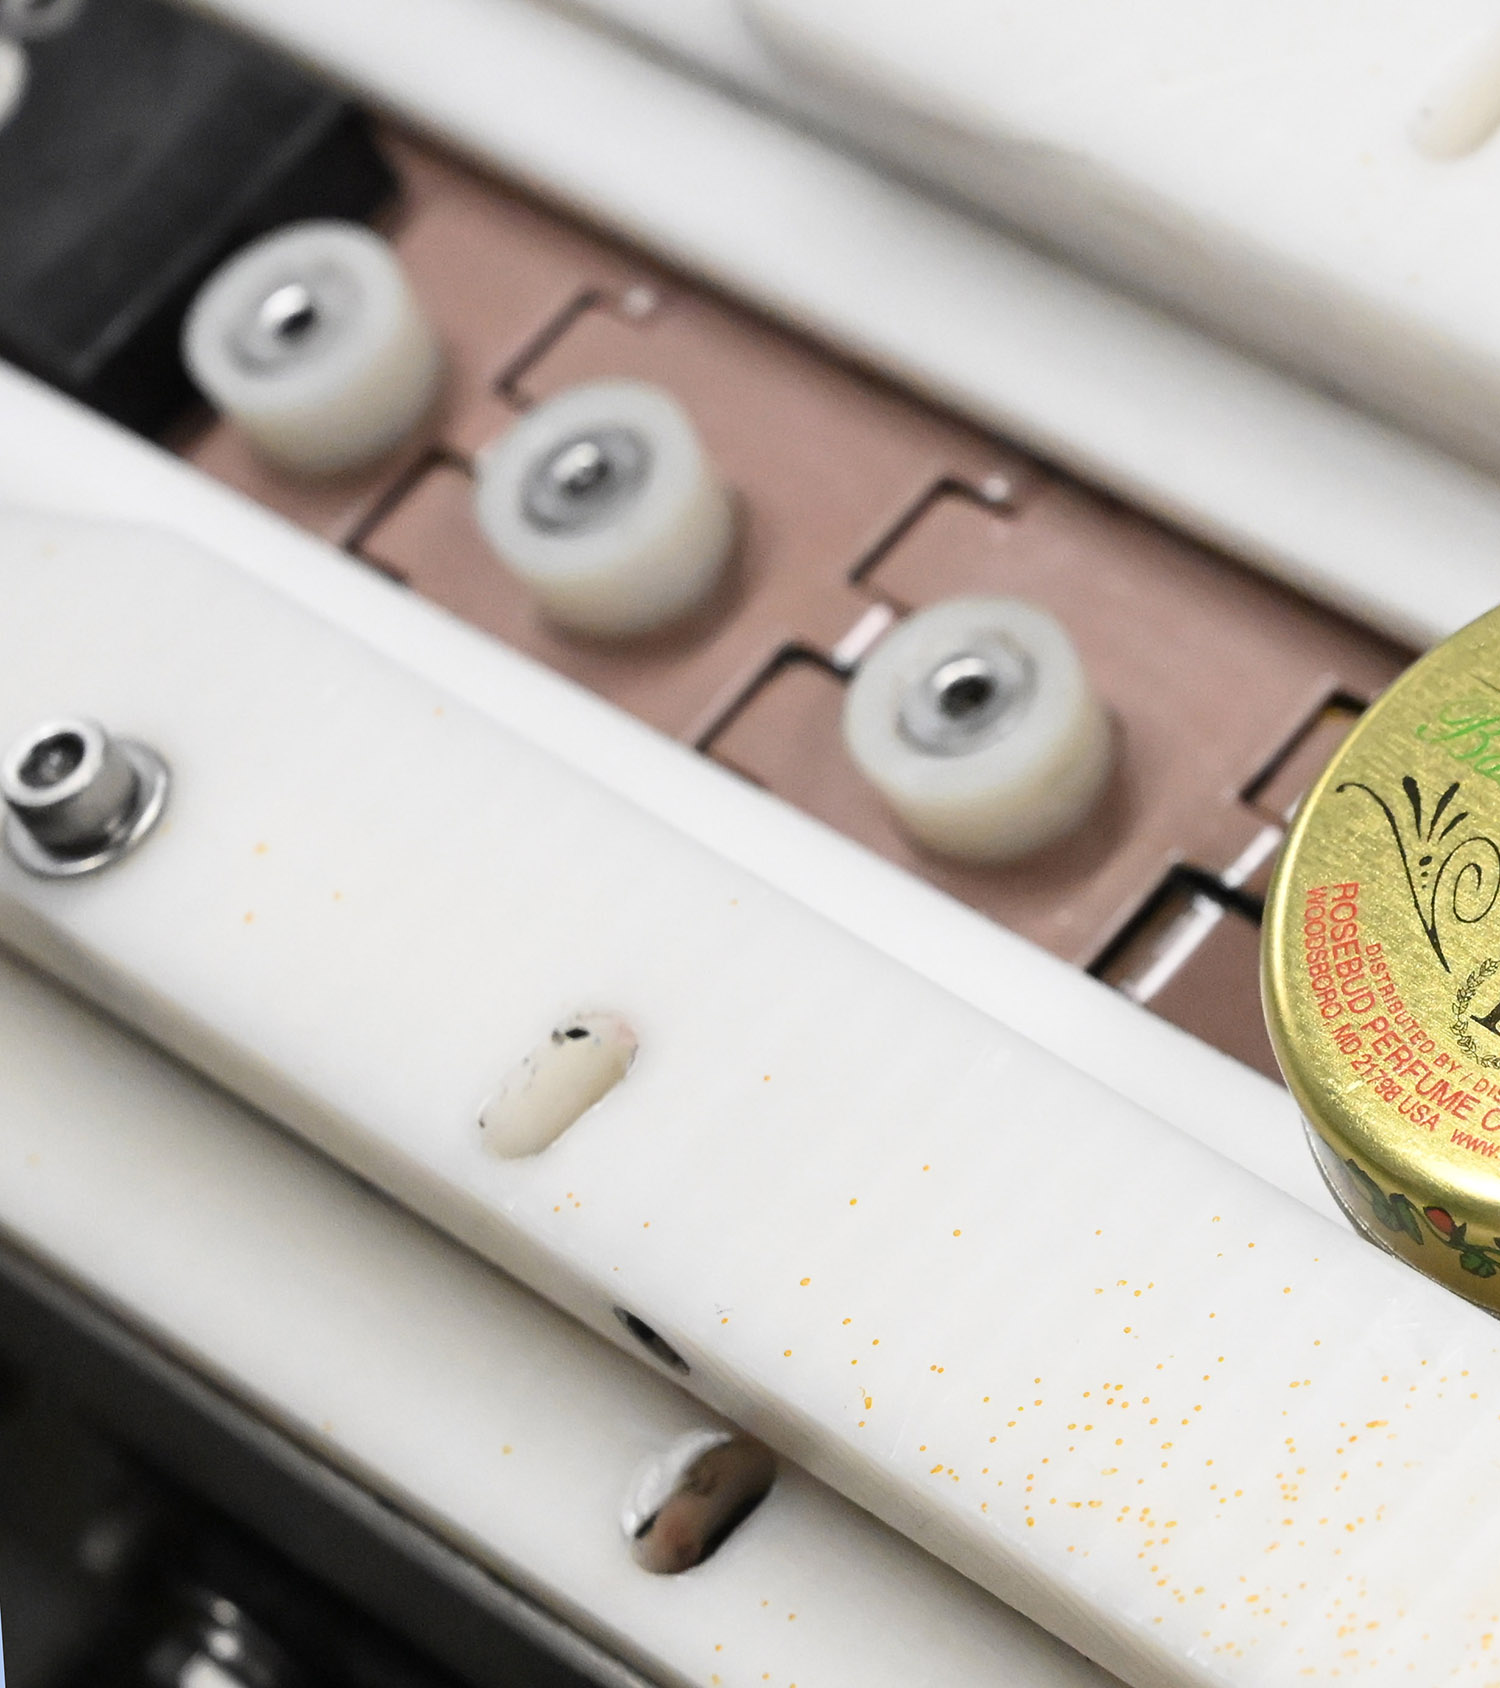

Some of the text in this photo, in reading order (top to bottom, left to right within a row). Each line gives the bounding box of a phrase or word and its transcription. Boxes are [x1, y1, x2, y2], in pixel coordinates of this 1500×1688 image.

[1304, 886, 1344, 1026] WOODSBORO,
[1331, 1023, 1362, 1054] MD
[1351, 1054, 1403, 1102] 21798
[1398, 1095, 1440, 1132] USA
[1329, 882, 1375, 1014] ROSEBUD
[1360, 1016, 1481, 1121] PERFUME
[1366, 943, 1435, 1053] DISTRIBUTED
[1433, 1053, 1462, 1073] BY
